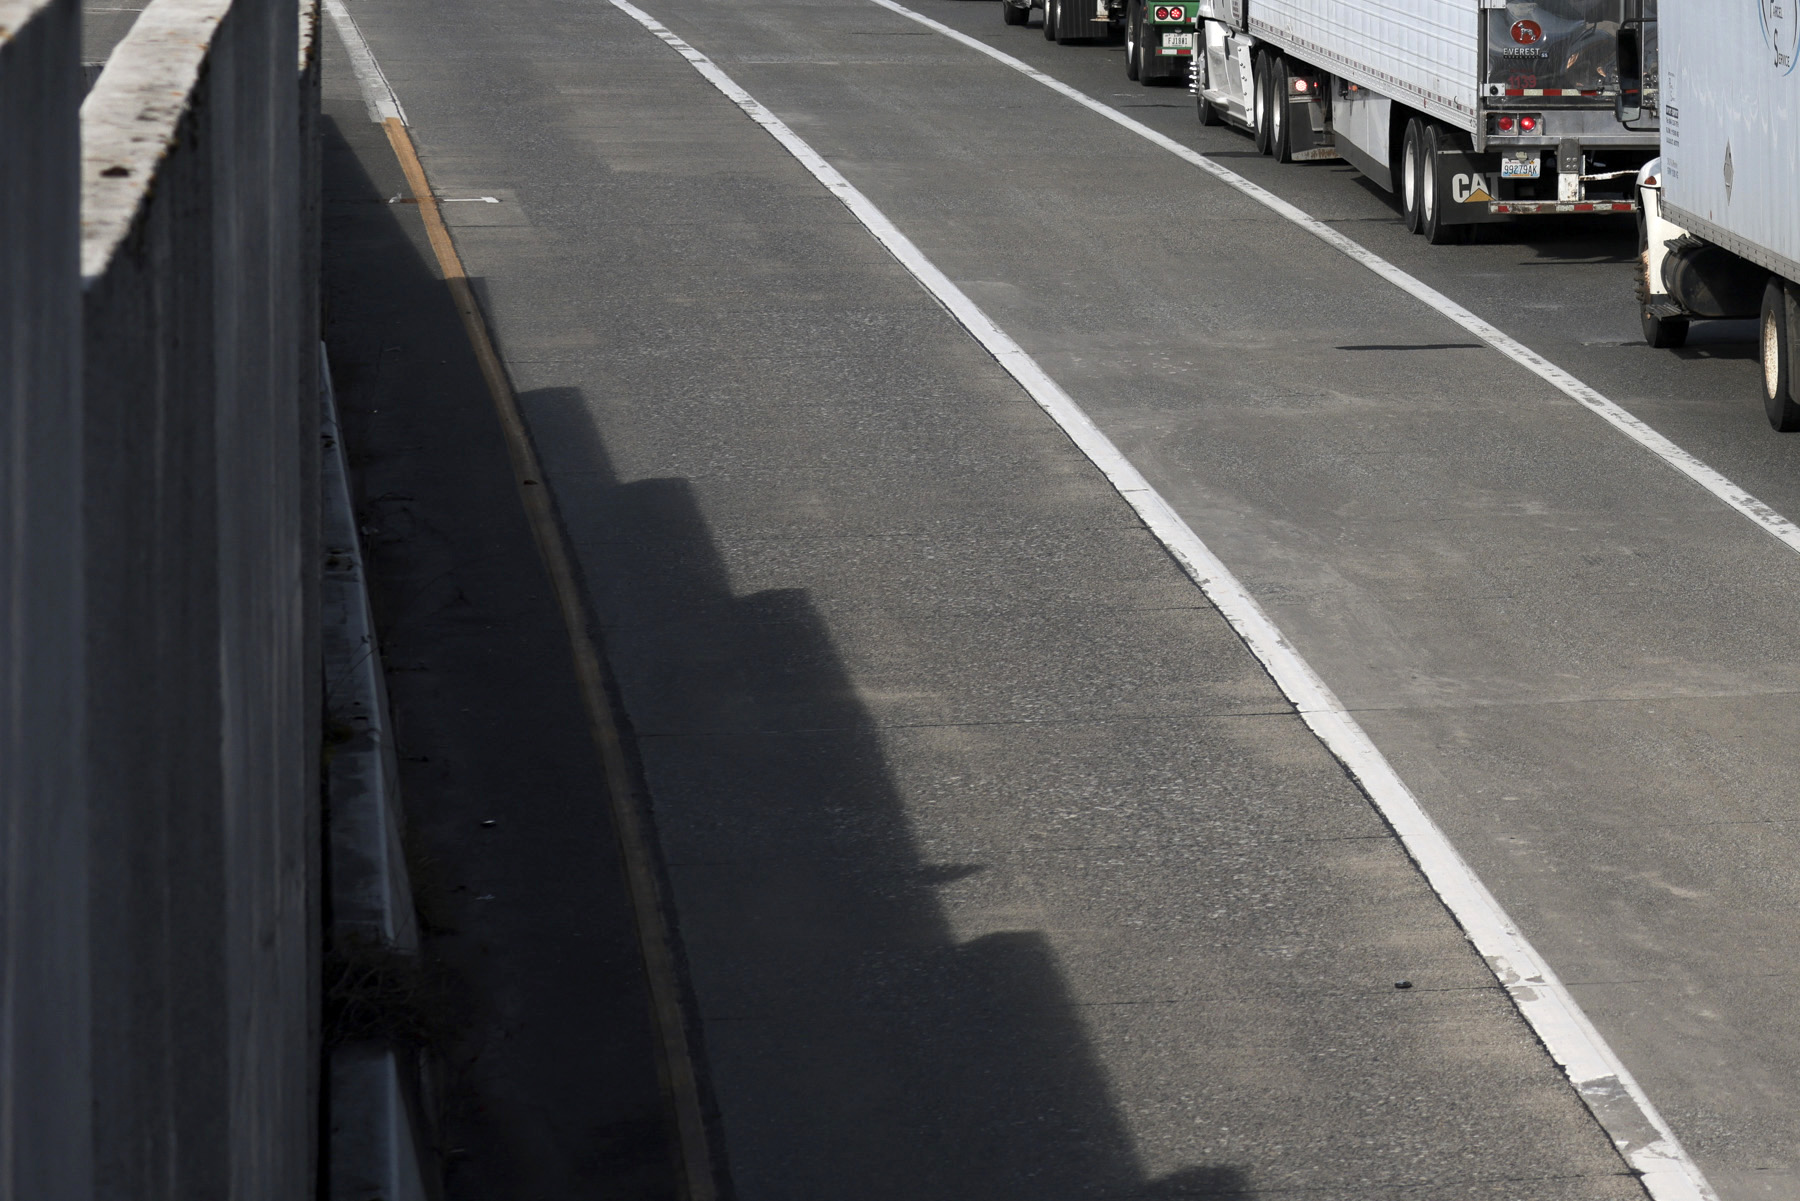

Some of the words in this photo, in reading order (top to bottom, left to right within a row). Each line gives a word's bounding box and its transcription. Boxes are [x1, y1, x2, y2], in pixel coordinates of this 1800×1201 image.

[1503, 47, 1540, 56] EVEREST
[1773, 28, 1791, 68] SERVICE
[1508, 74, 1537, 89] 1139
[1504, 164, 1537, 175] 99279AK
[1452, 172, 1500, 204] CAT
